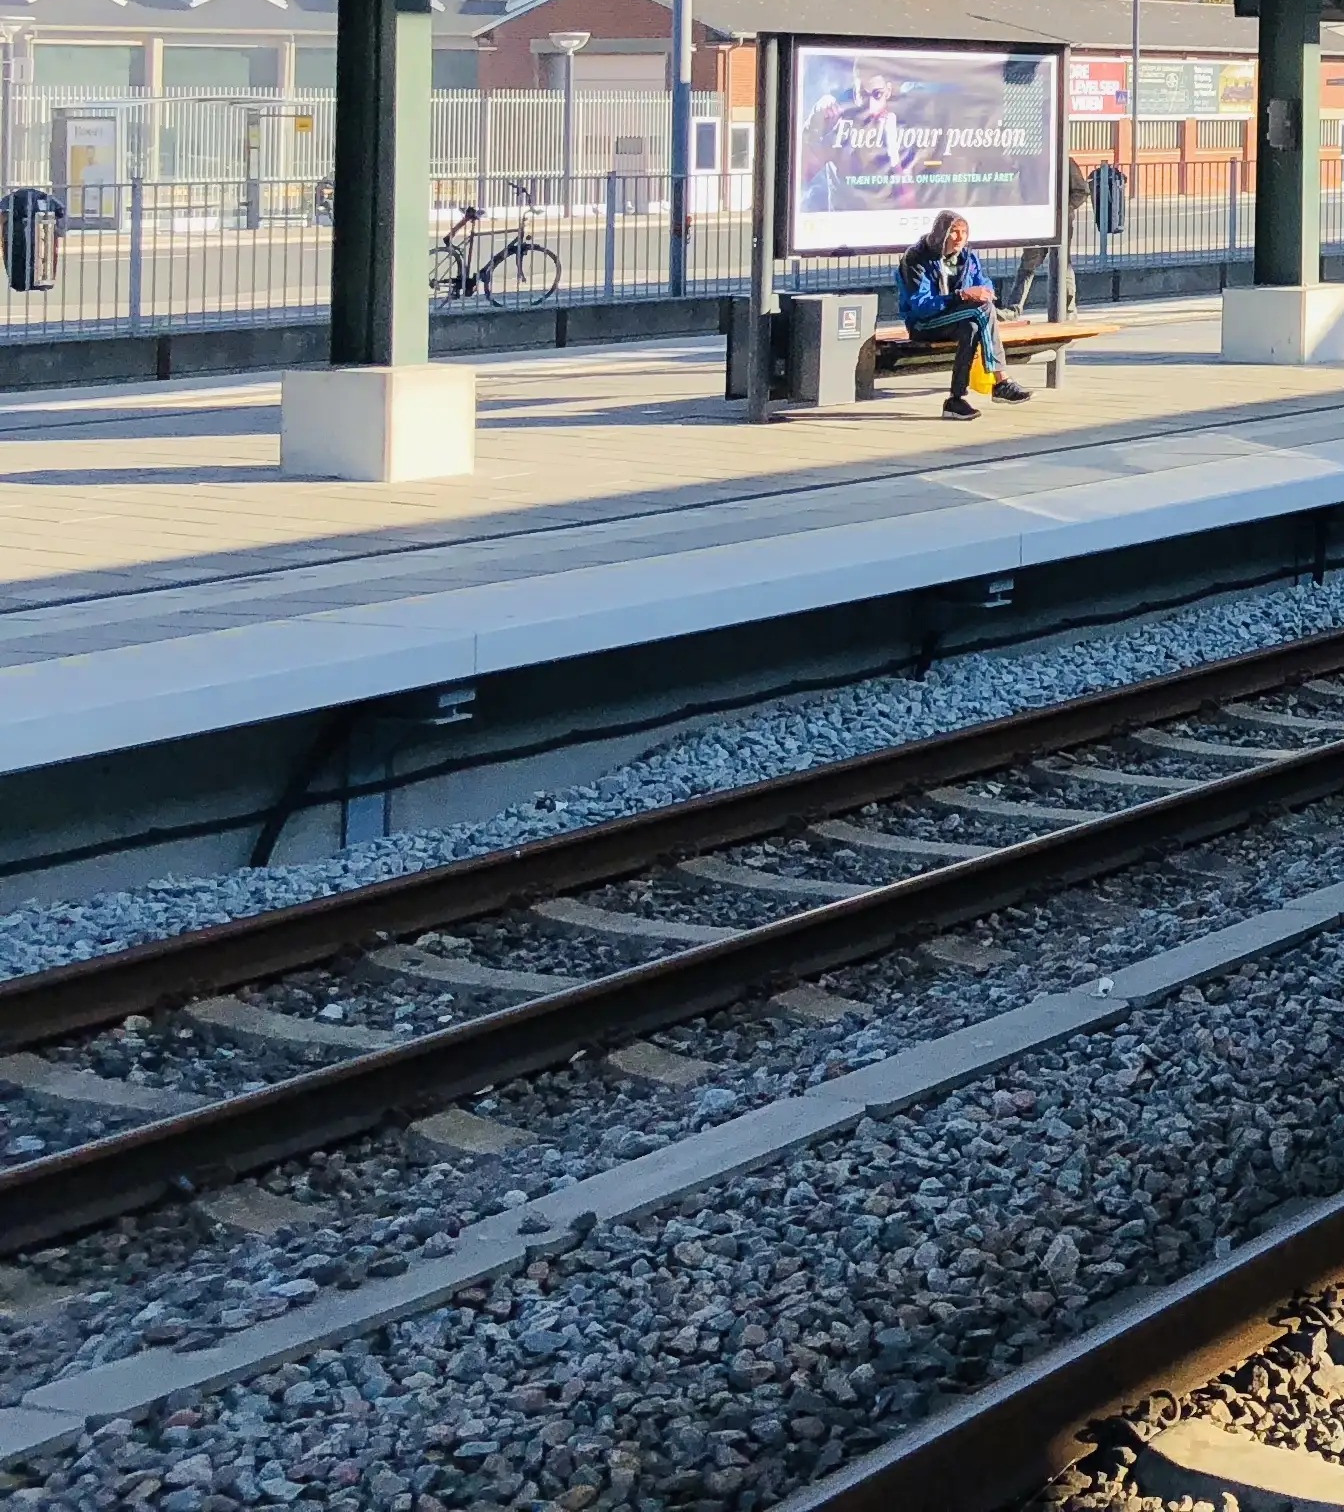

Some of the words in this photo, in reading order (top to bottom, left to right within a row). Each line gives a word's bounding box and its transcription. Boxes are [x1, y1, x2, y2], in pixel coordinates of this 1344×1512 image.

[832, 118, 886, 148] Fuel
[892, 126, 943, 151] your
[943, 119, 1026, 156] passion
[872, 175, 889, 185] FOR
[982, 173, 993, 182] AF
